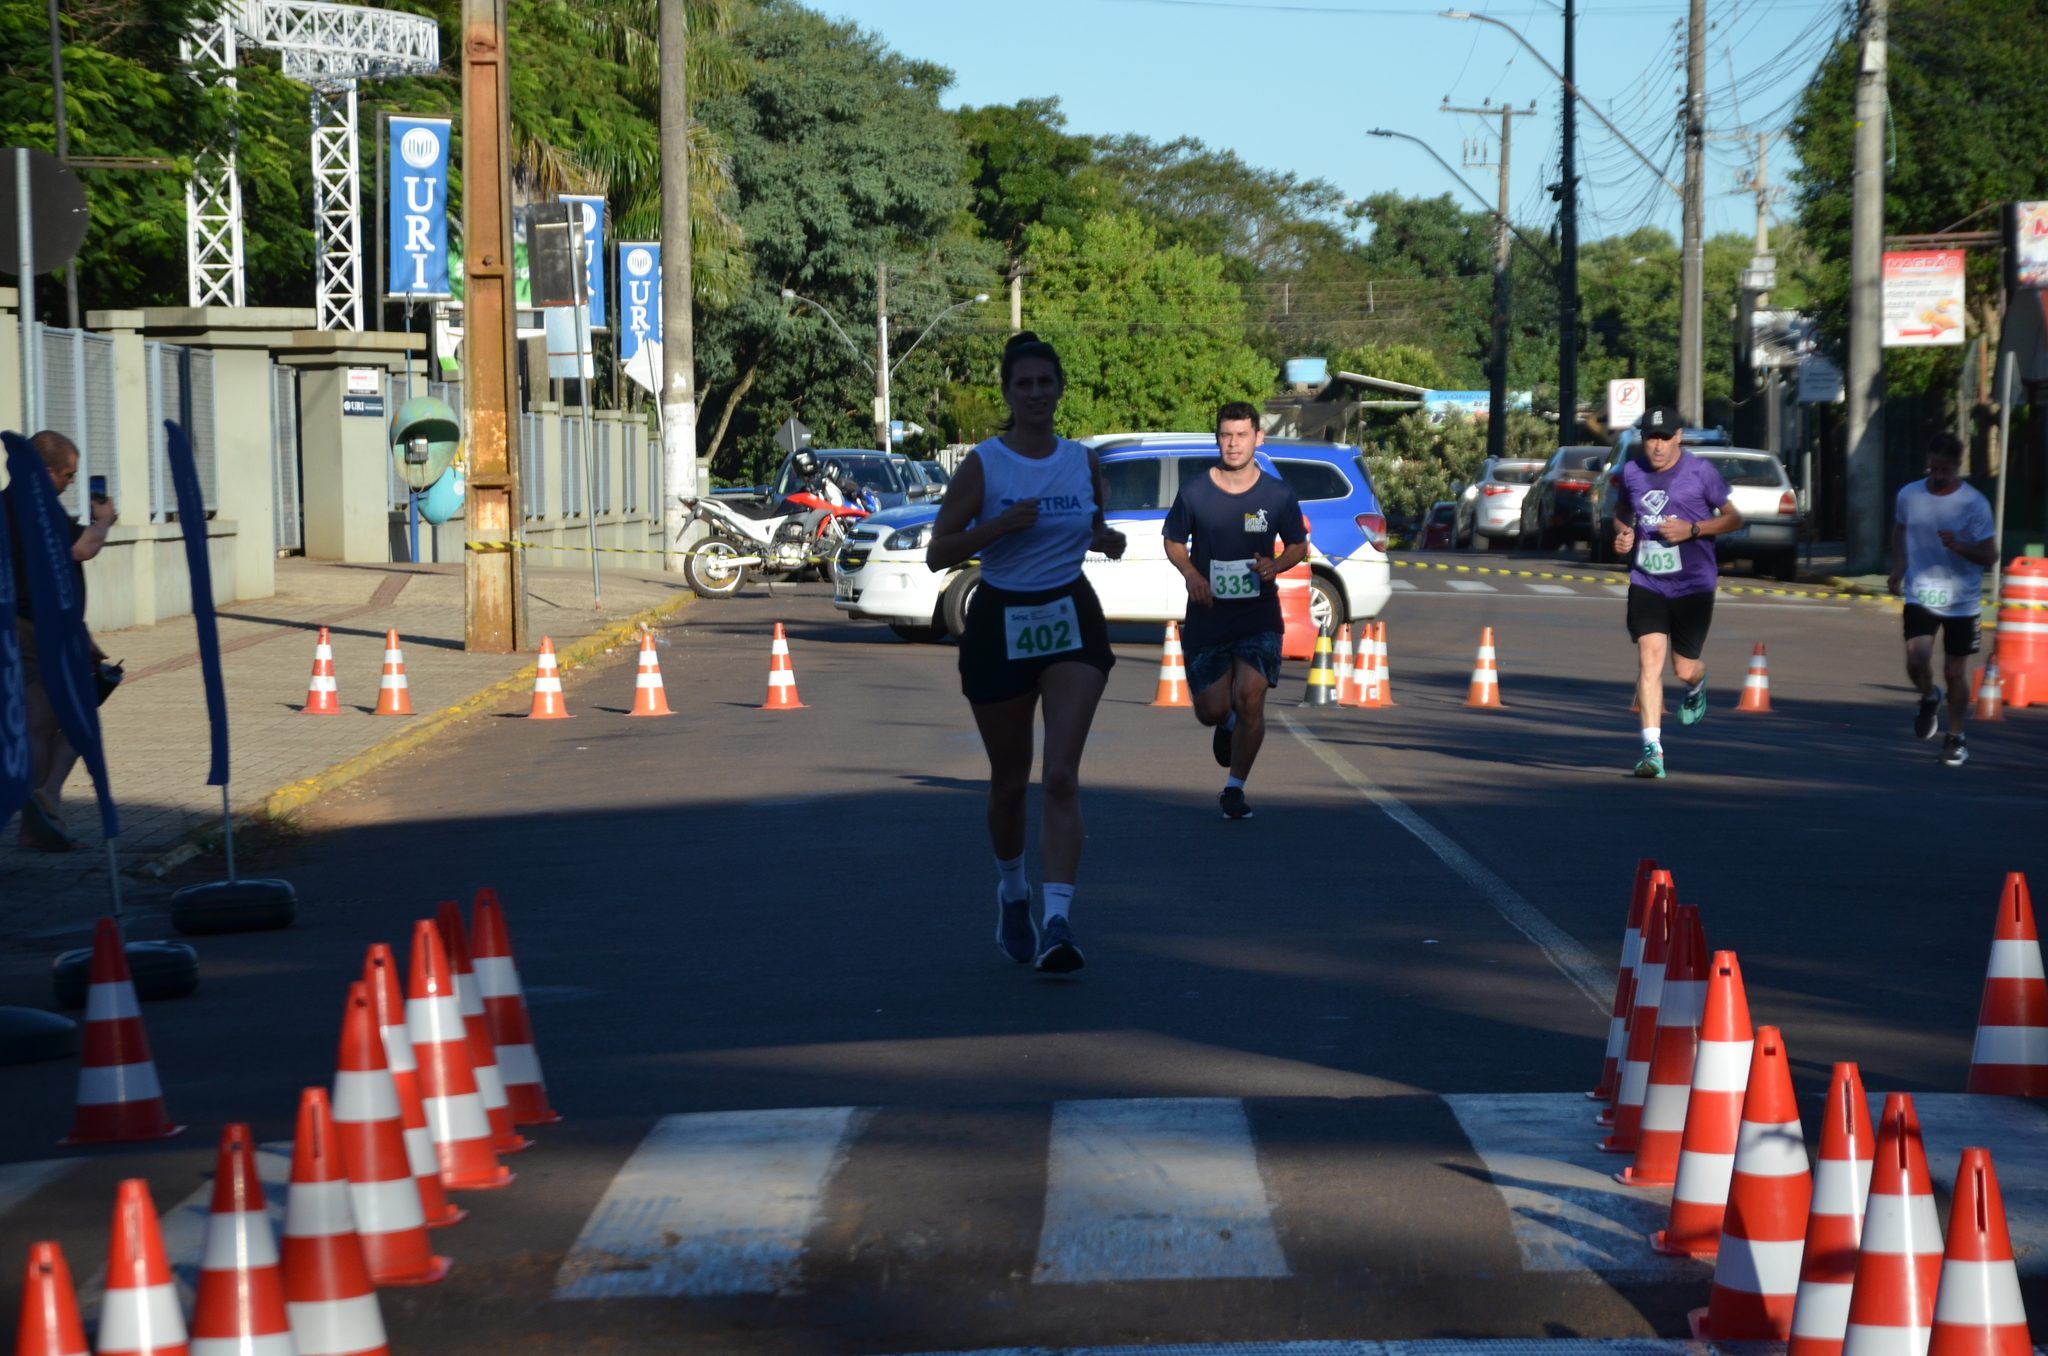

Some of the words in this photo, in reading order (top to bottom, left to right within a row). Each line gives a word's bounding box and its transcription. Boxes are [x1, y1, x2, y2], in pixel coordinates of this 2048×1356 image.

[404, 176, 437, 289] URI
[1643, 552, 1675, 571] 403
[1216, 575, 1254, 595] 335
[1017, 620, 1072, 653] 402
